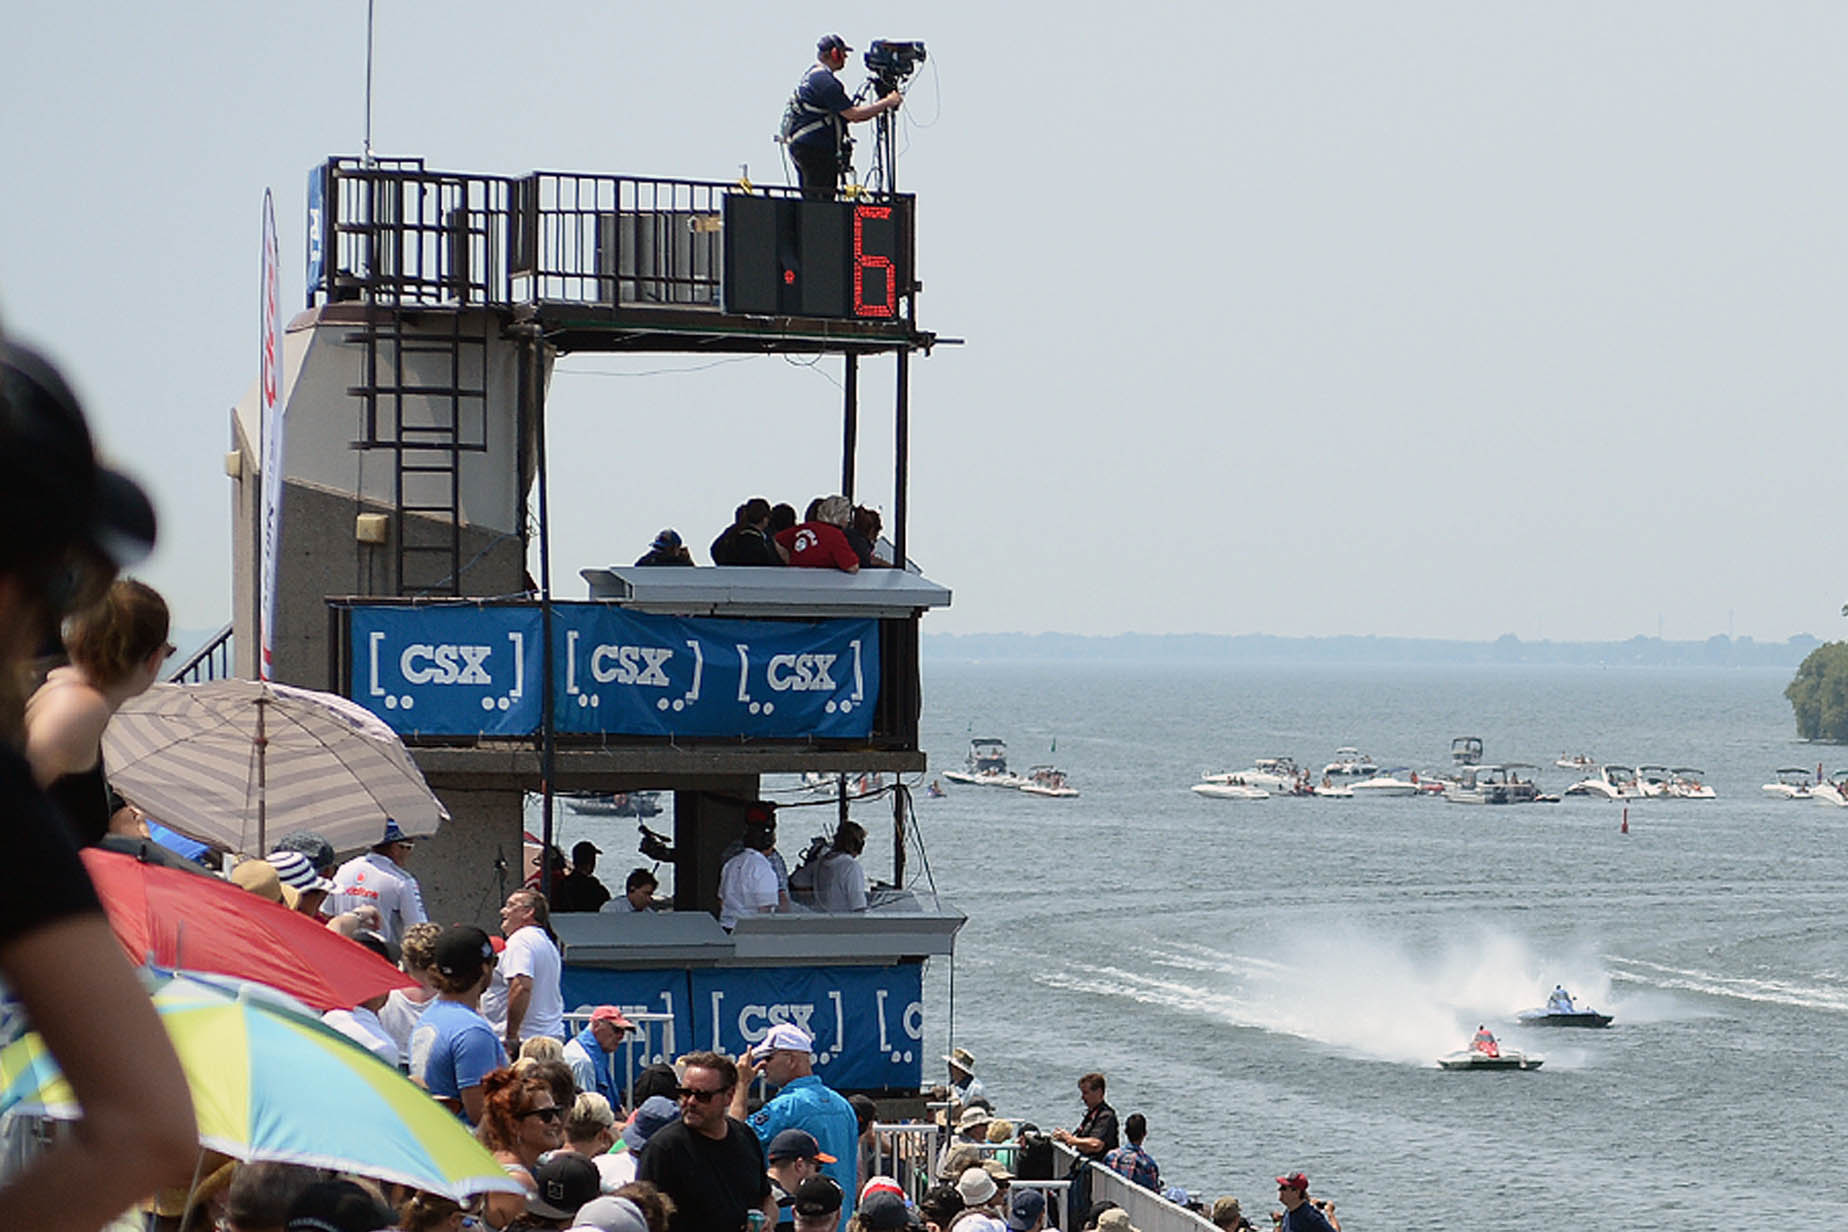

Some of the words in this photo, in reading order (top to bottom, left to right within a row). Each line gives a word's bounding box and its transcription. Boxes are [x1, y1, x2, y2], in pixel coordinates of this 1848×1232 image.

[854, 205, 896, 317] 6
[400, 644, 493, 685] CSX
[591, 645, 673, 687] CSX
[767, 654, 836, 692] CSX
[738, 1004, 816, 1043] CSX
